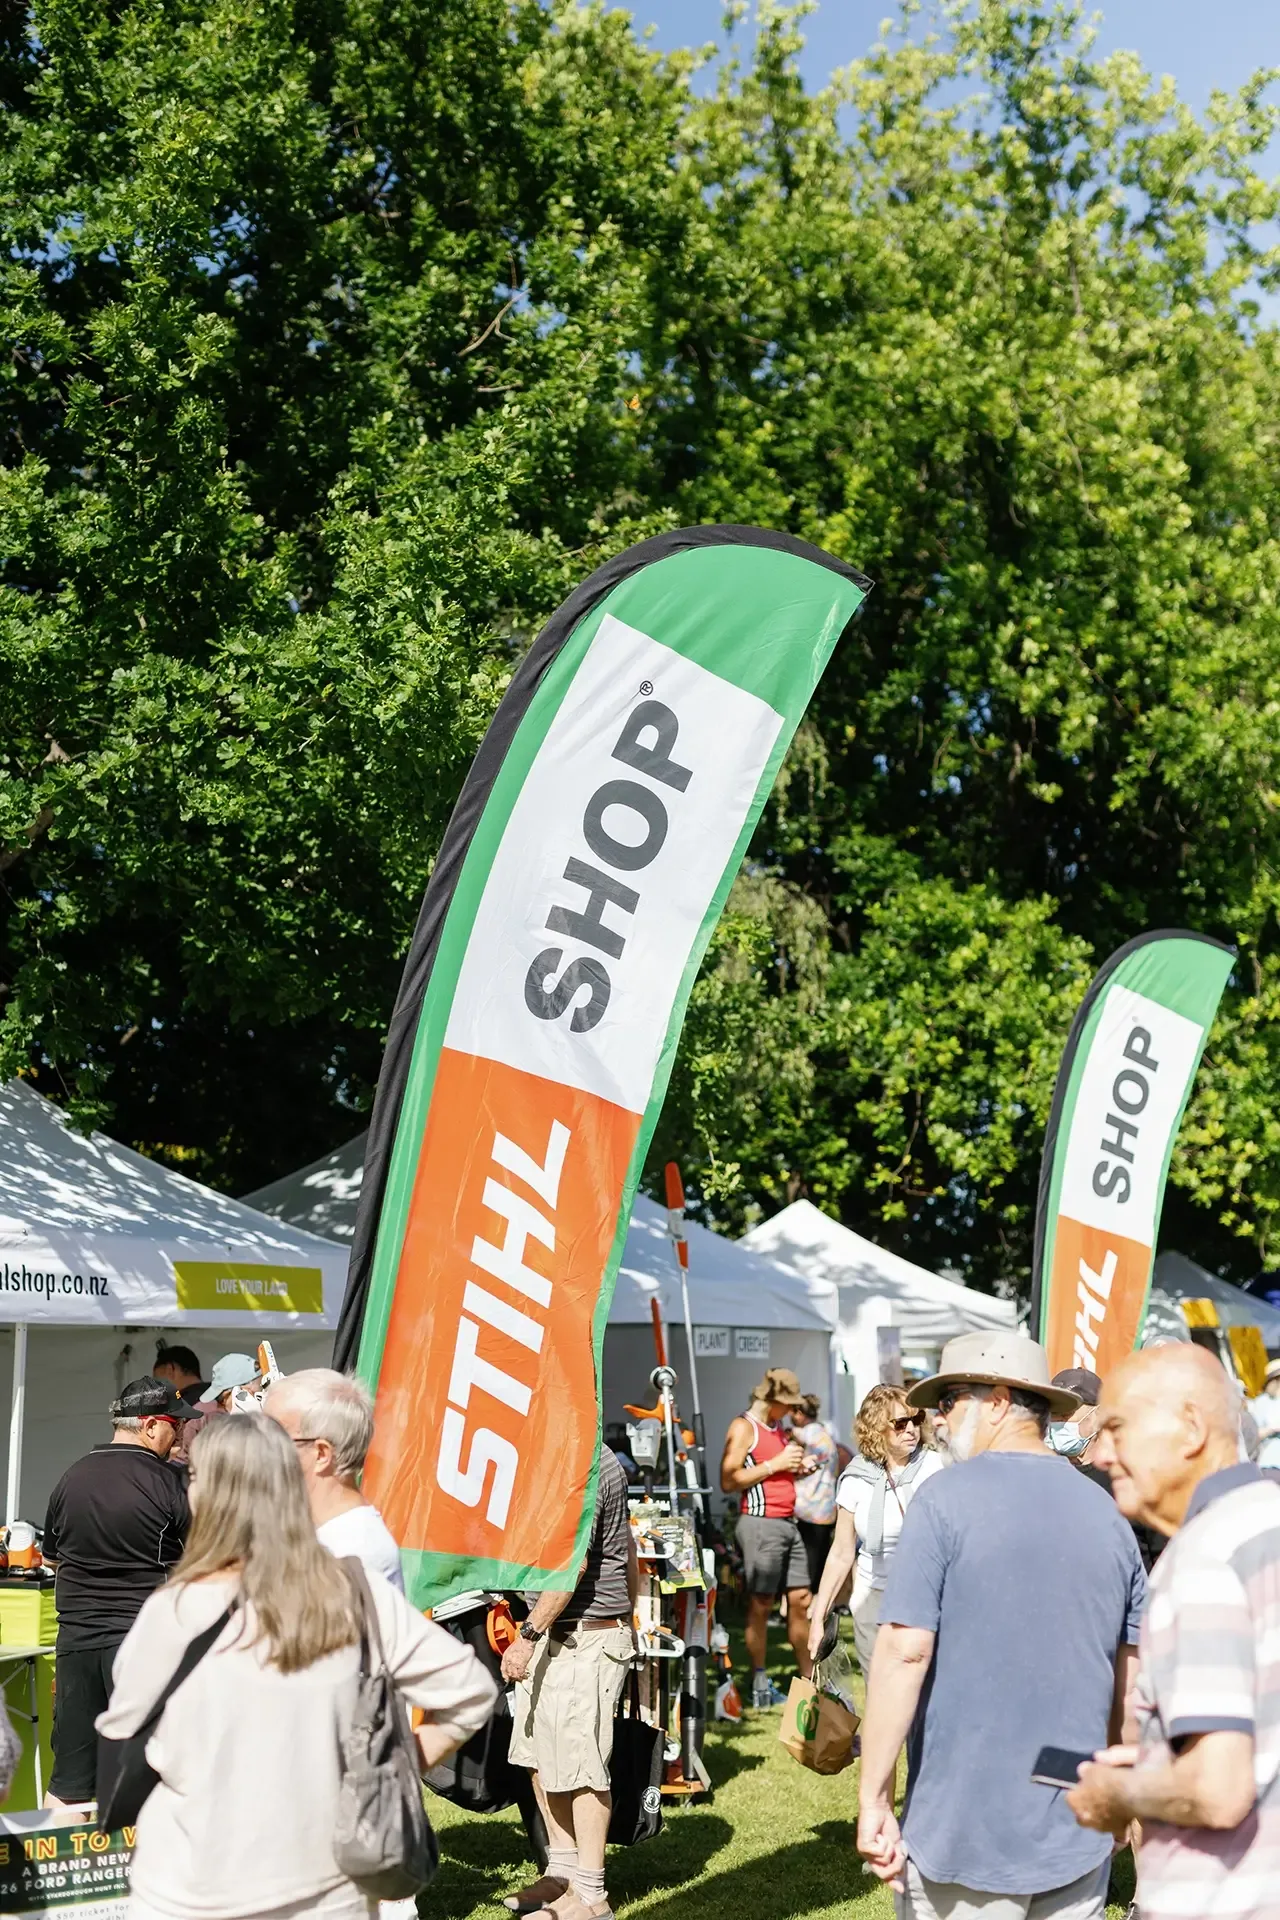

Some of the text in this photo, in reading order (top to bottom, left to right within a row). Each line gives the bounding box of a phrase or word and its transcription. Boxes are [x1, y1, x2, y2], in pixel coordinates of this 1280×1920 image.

[215, 1278, 288, 1296] LOVE YOUR LAND
[437, 1119, 571, 1530] STIHL
[1072, 1249, 1118, 1374] IHL
[699, 1331, 727, 1350] PLANT
[24, 1836, 58, 1861] IN
[69, 1831, 110, 1854] TO
[22, 1852, 131, 1878] A BRAND NEW
[25, 1876, 67, 1892] FORD
[72, 1866, 133, 1885] RANGER
